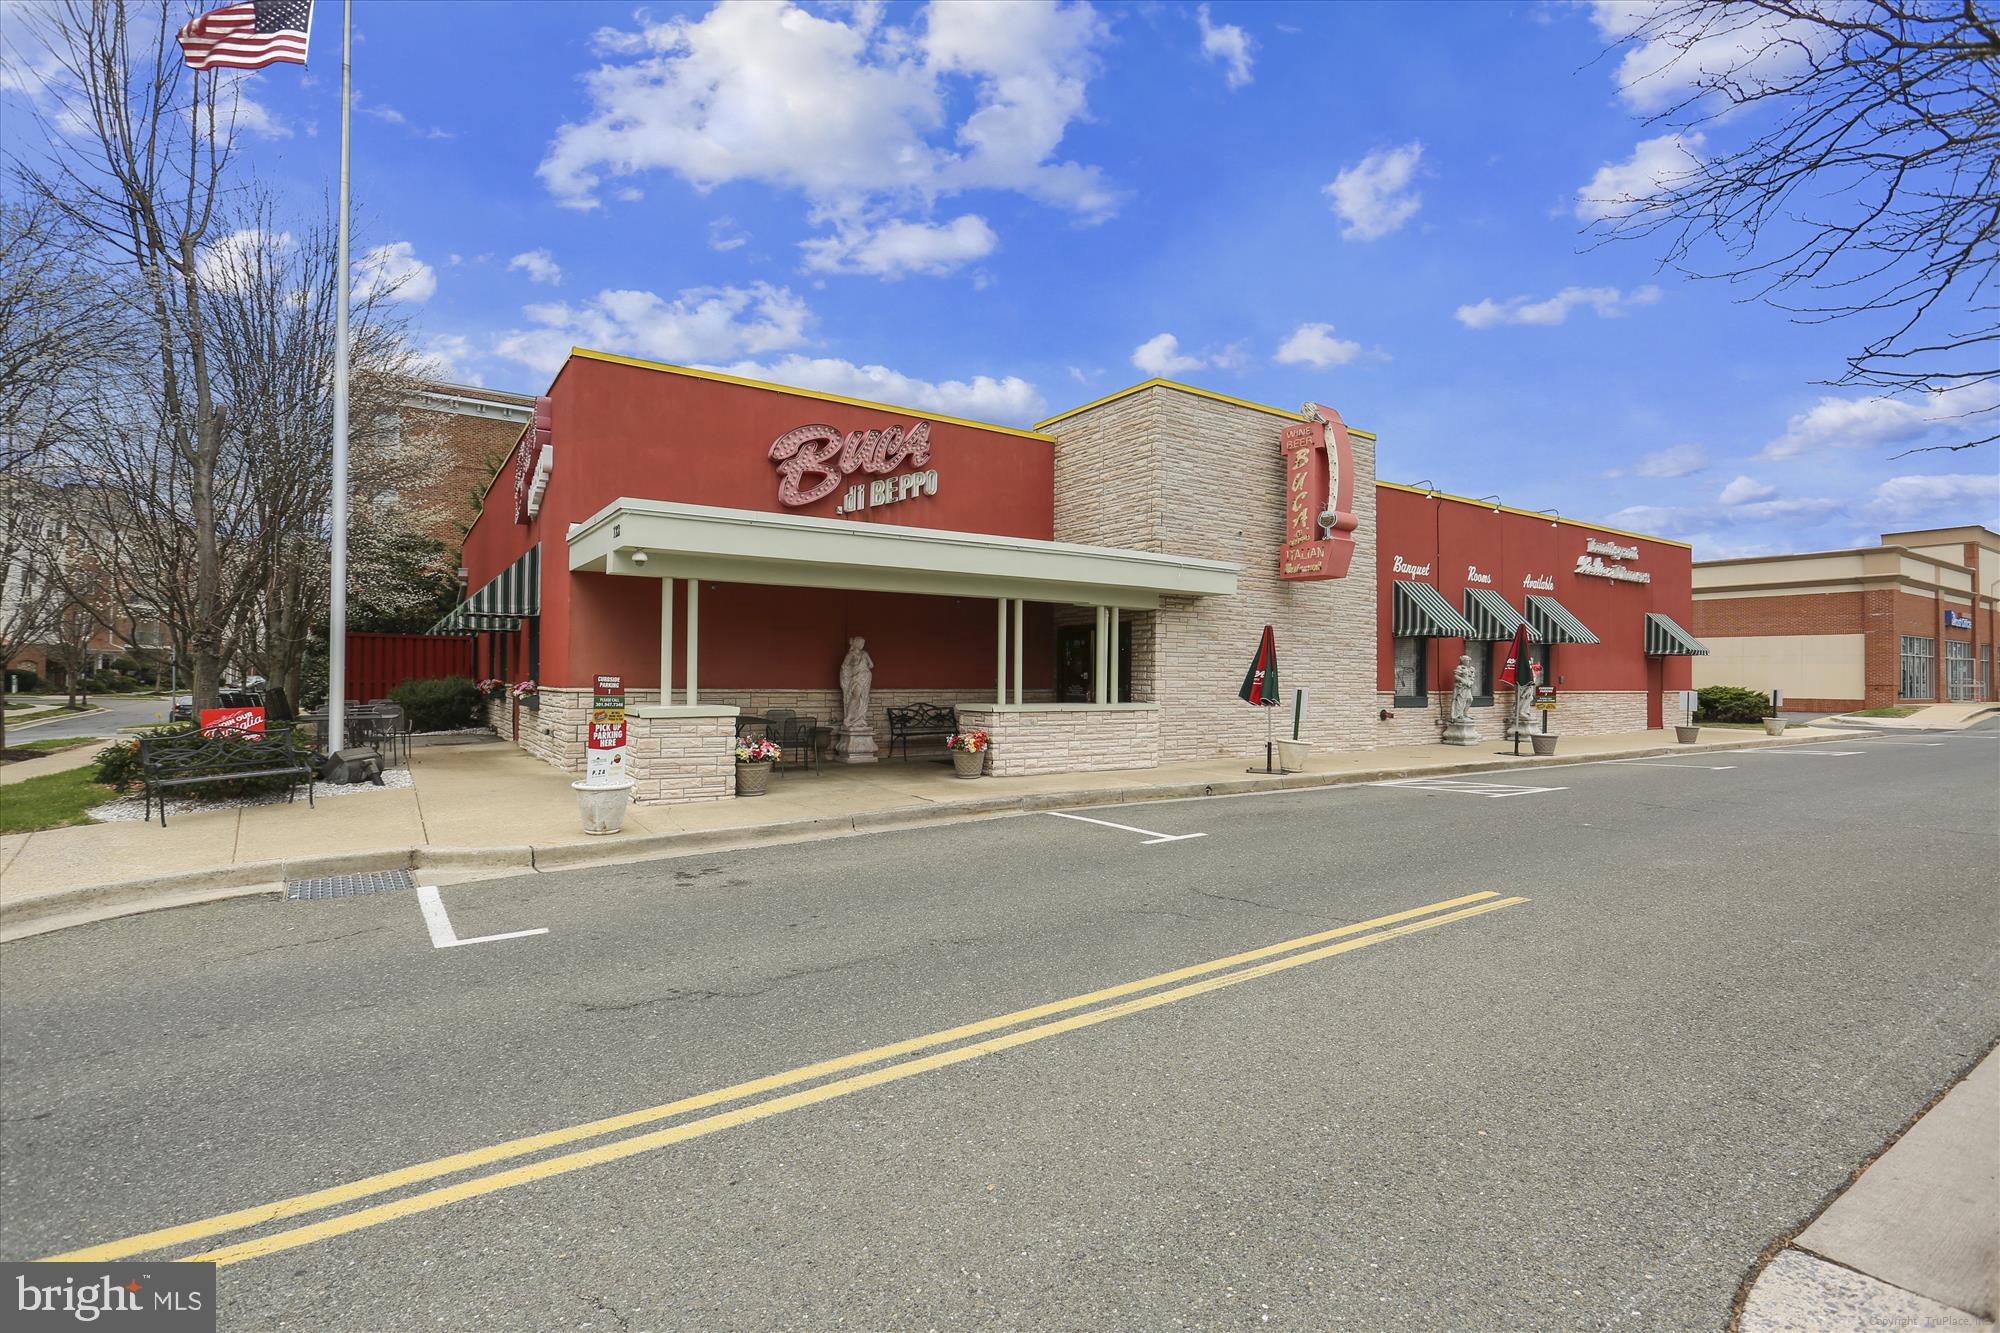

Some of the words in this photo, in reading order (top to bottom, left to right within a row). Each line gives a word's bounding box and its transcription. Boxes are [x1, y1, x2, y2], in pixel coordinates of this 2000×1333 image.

[1286, 427, 1311, 438] WINE
[1286, 437, 1313, 449] BEER
[767, 421, 931, 507] BUCA
[843, 484, 866, 513] di
[870, 469, 938, 507] BEPPO
[1393, 555, 1431, 580] Banquet
[1468, 565, 1492, 584] Rooms
[1523, 573, 1554, 591] Available
[235, 711, 254, 722] OUR
[595, 724, 611, 732] PICK
[593, 731, 623, 740] PARKING
[600, 739, 617, 747] HERE
